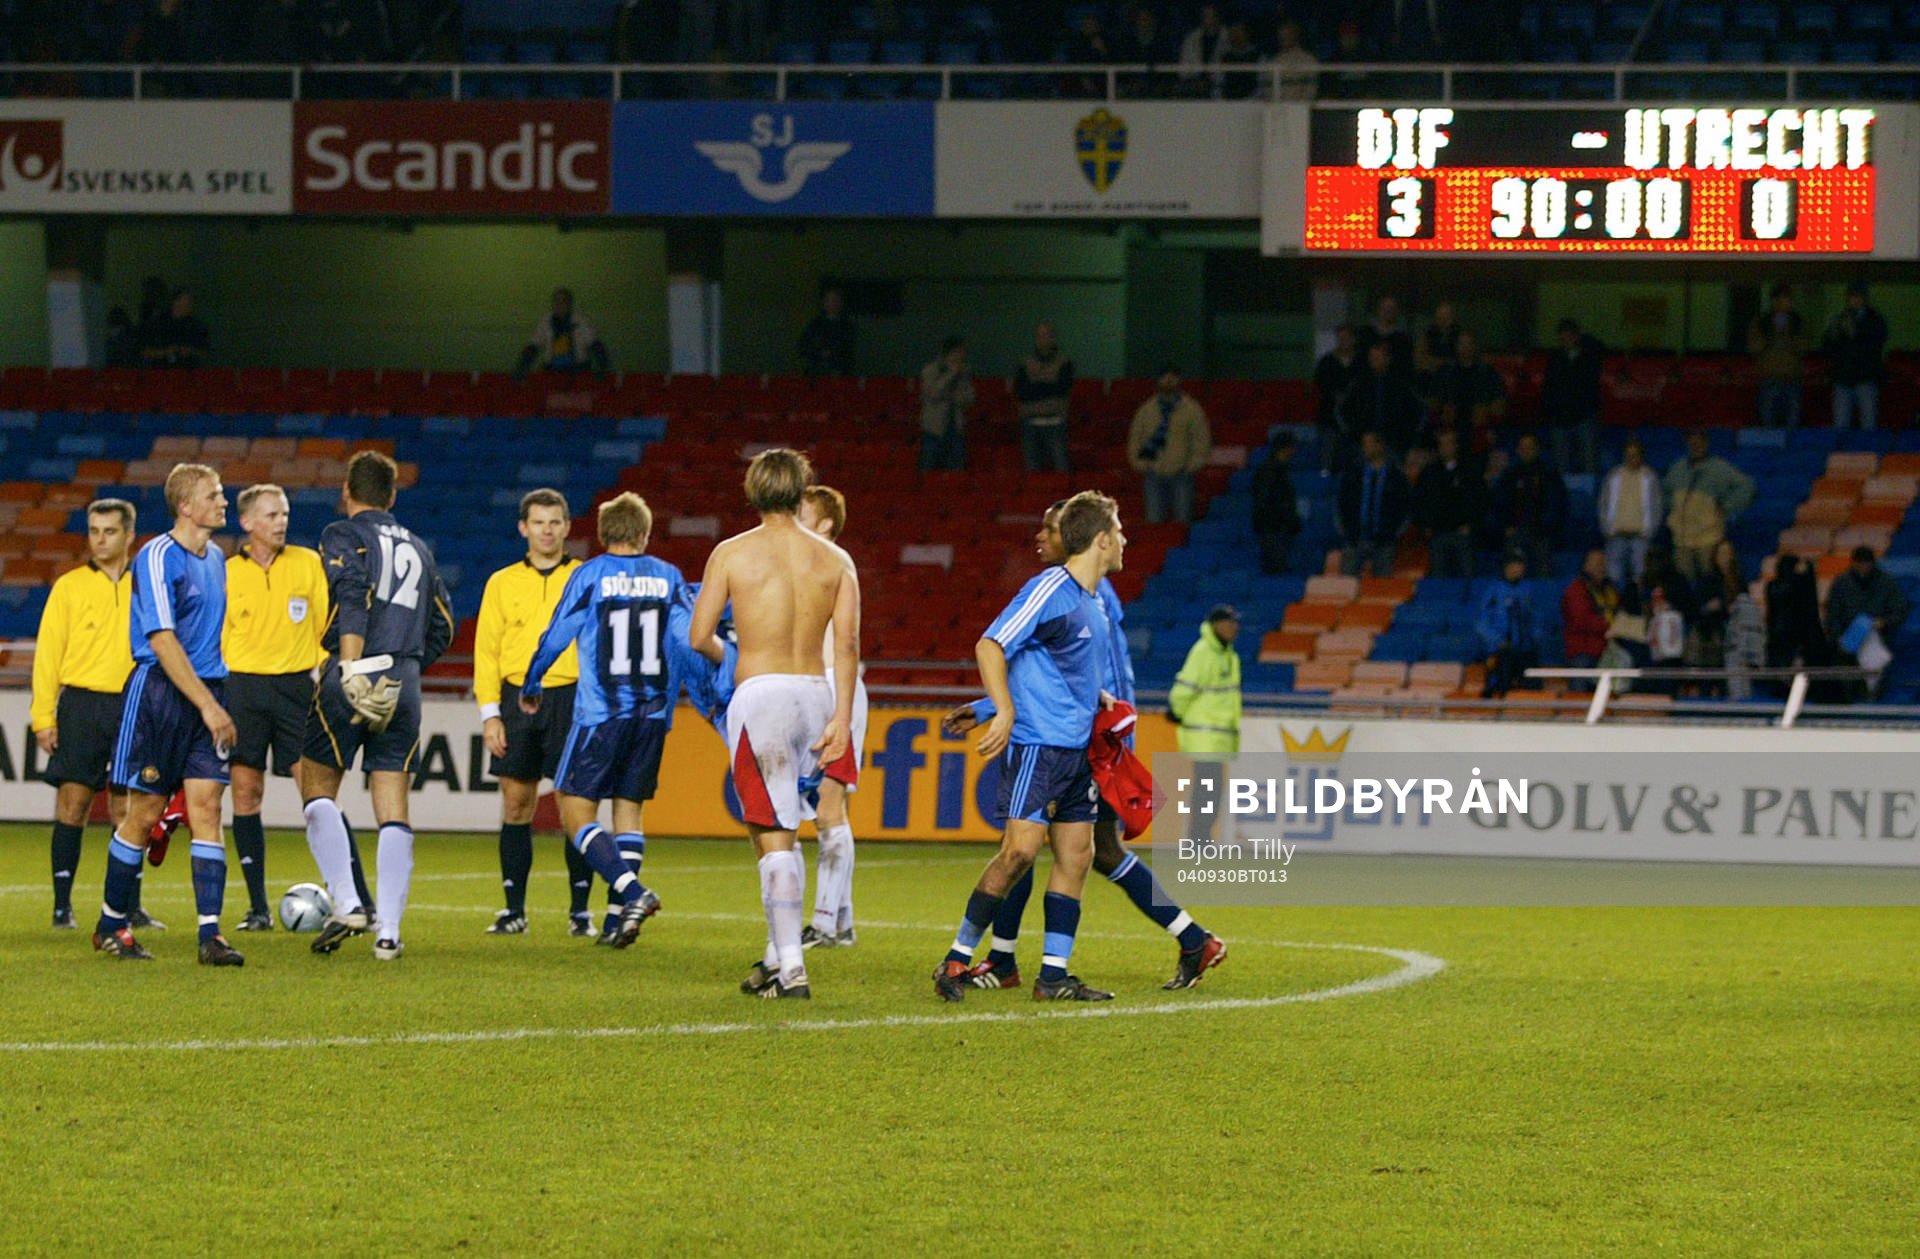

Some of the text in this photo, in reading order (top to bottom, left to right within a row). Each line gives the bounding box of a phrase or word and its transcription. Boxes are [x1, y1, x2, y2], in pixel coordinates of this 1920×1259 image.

[305, 122, 598, 192] Scandic
[751, 114, 793, 147] SJ
[1357, 108, 1453, 169] DIF
[1624, 108, 1876, 170] UTRECHT
[65, 169, 274, 195] SVENSKA SPEL
[1386, 177, 1793, 240] 3 90:00 0
[376, 534, 423, 610] 12
[608, 608, 662, 675] 11
[1663, 784, 1719, 834] &
